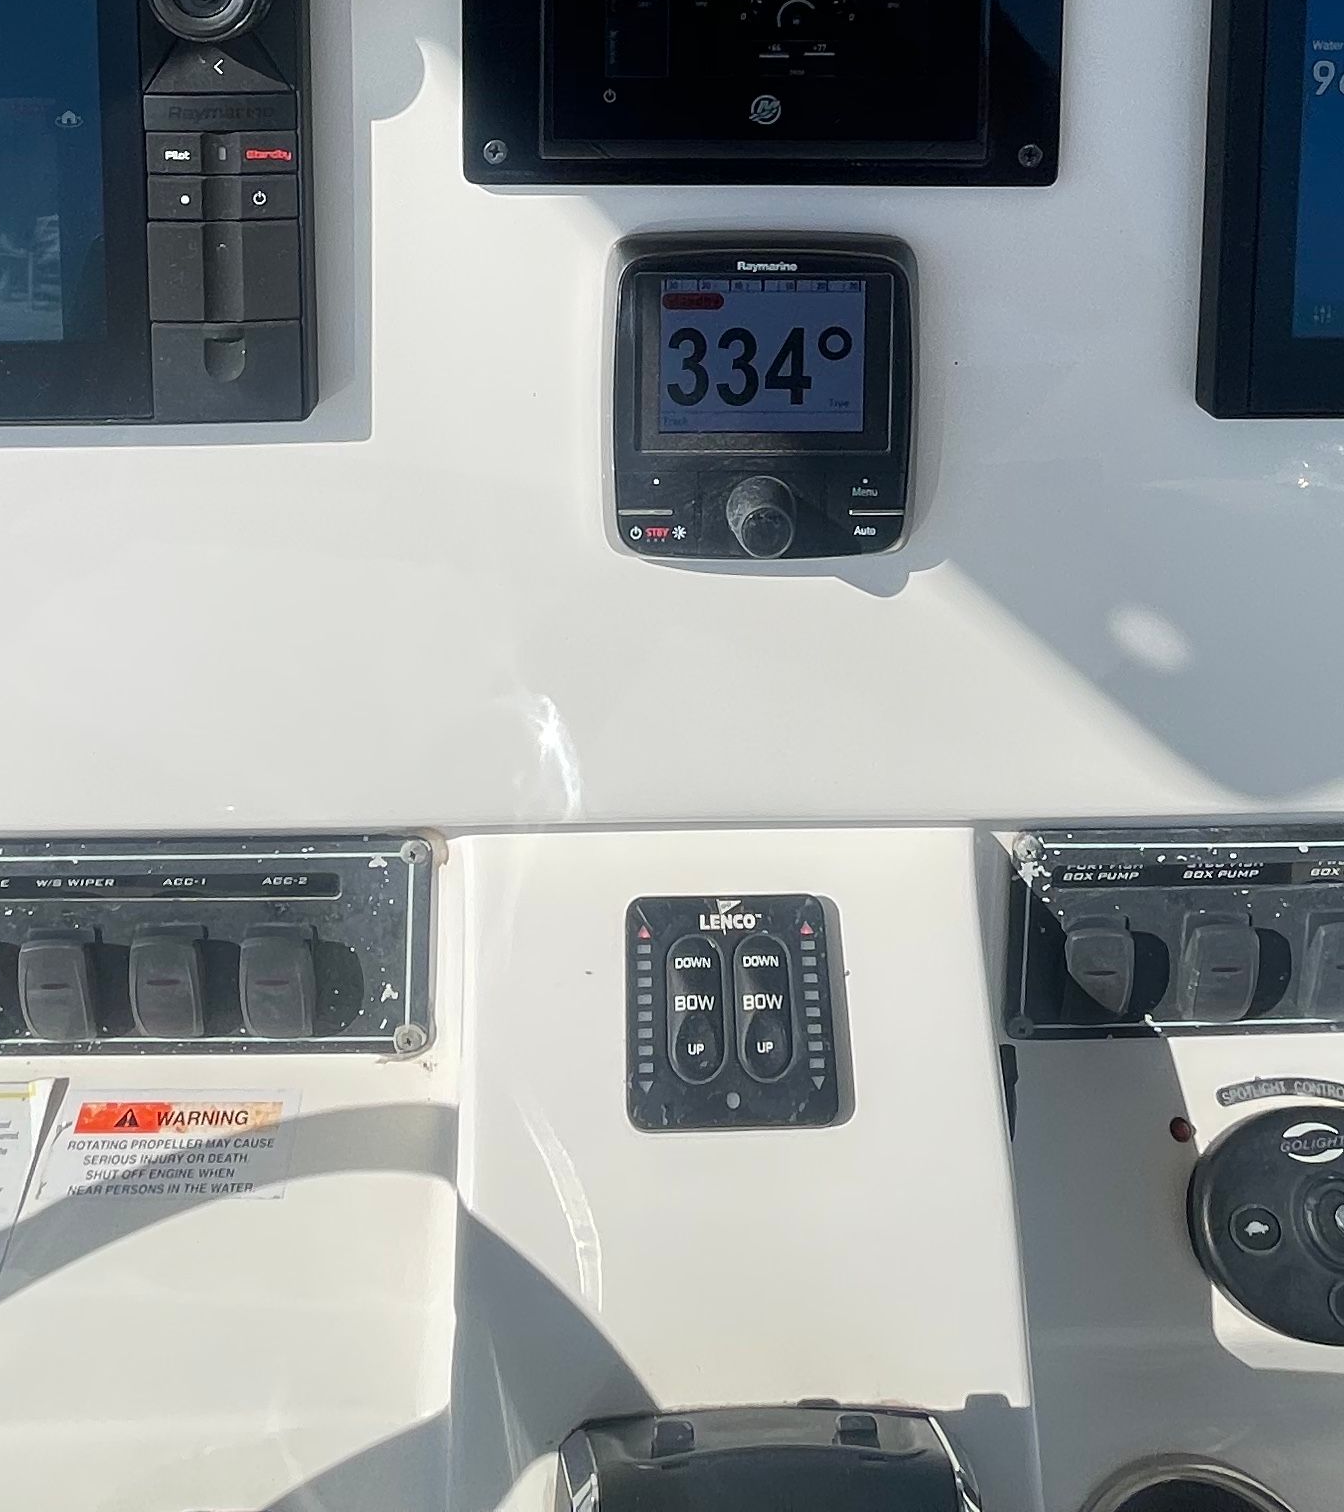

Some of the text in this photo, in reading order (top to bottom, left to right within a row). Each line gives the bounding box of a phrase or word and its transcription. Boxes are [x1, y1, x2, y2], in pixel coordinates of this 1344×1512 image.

[164, 150, 191, 162] Pilot
[736, 261, 798, 272] Raymarine
[852, 487, 878, 498] Menu
[853, 525, 877, 537] Auto
[1063, 871, 1140, 881] BOX PUMP
[1183, 869, 1260, 879] BOX PUMP
[1310, 868, 1340, 877] BOX
[67, 878, 115, 887] WIPER
[674, 957, 711, 969] DOWN
[742, 955, 779, 968] DOWN
[674, 995, 715, 1012] BOW
[742, 994, 783, 1010] BOW
[687, 1043, 705, 1055] UP
[757, 1041, 774, 1054] UP
[1221, 1081, 1286, 1104] SPOTLIGHT
[156, 1110, 249, 1126] WARNING
[67, 1138, 275, 1151] ROTATING PROPELLER MAY CAUSE
[83, 1154, 137, 1166] SERIOUS
[139, 1153, 185, 1165] INJURY
[186, 1153, 206, 1163] OR
[85, 1168, 236, 1180] SHUT OFF ENGINE WHEN
[67, 1185, 103, 1196] NEAR
[105, 1184, 165, 1196] PERSONS
[167, 1183, 180, 1194] IN
[184, 1183, 207, 1193] THE
